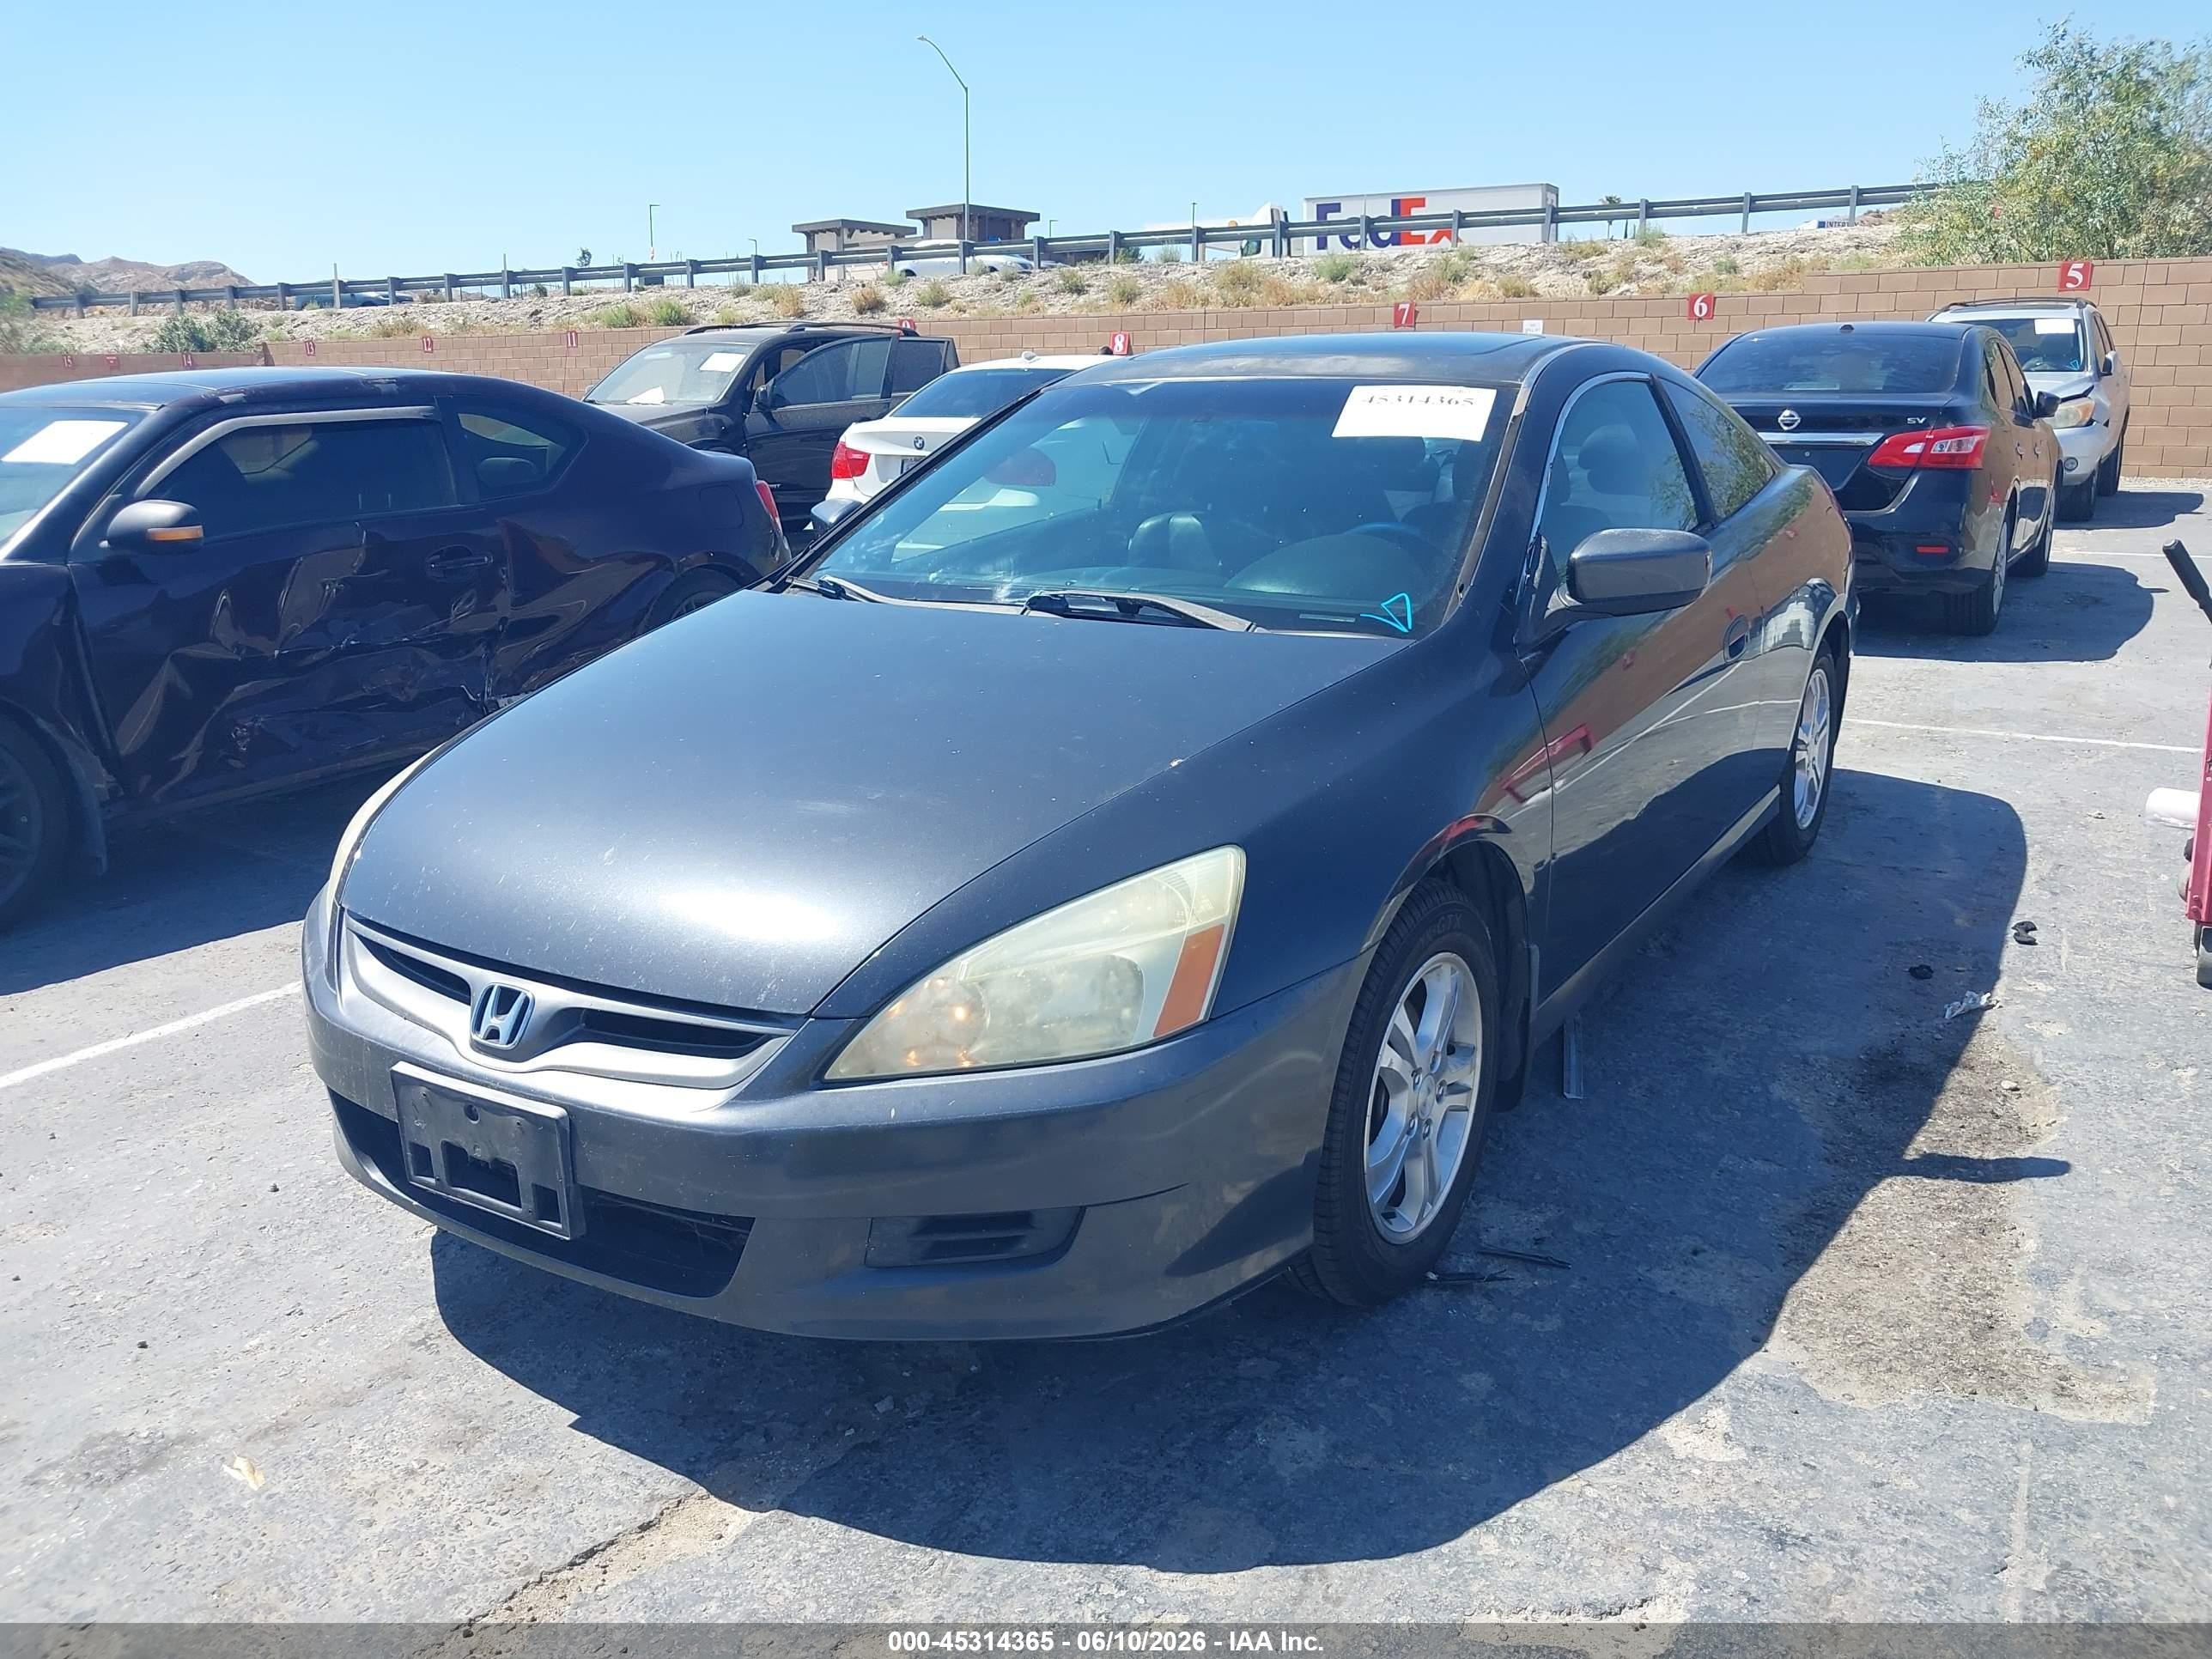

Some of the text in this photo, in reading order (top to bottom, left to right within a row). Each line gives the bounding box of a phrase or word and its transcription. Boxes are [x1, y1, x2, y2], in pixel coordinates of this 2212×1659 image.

[2065, 263, 2084, 289] 5
[1398, 303, 1410, 325] 7
[1693, 295, 1708, 317] 6
[422, 337, 432, 351] 12
[567, 331, 576, 348] 11
[1113, 334, 1125, 352] 8
[305, 342, 315, 355] 13
[64, 356, 73, 368] 15
[182, 355, 192, 367] 14
